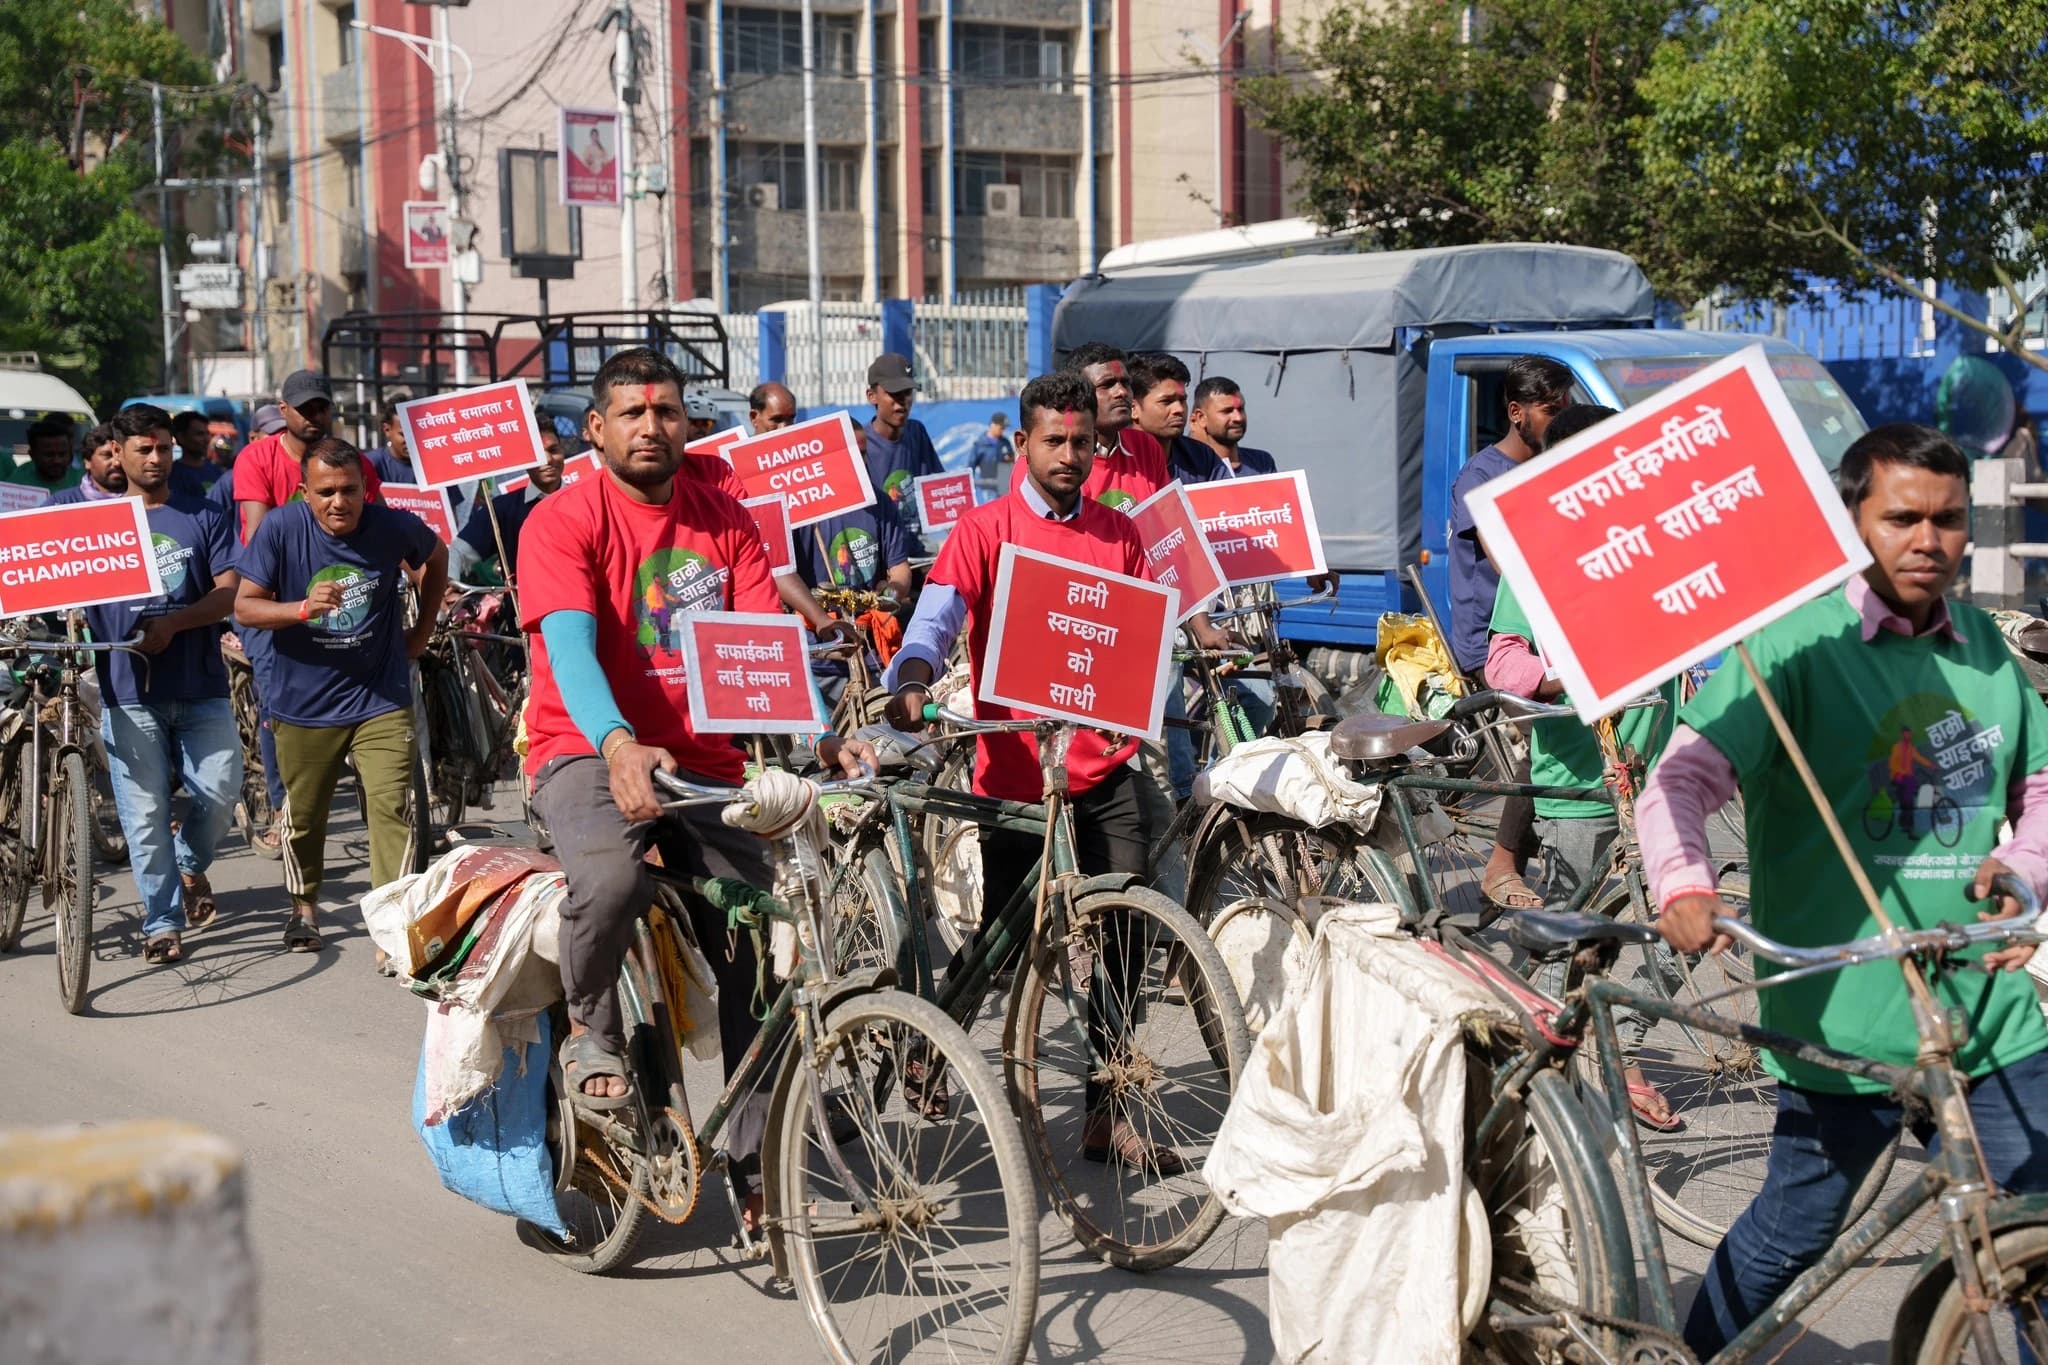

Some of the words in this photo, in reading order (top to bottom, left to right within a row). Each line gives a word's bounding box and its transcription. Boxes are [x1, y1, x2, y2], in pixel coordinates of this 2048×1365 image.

[459, 401, 503, 421] समानता
[505, 399, 514, 411] र
[452, 453, 473, 466] कल
[477, 445, 502, 461] यात्रा
[756, 439, 824, 471] HAMRO
[1548, 405, 1731, 521] सफाईकर्मीको
[769, 461, 826, 490] CYCLE
[384, 497, 442, 511] POWERING
[785, 482, 836, 510] ATRA
[1198, 502, 1293, 534] फाईकर्मीलाई
[1576, 525, 1654, 581] लागि
[1655, 464, 1765, 540] साईकल
[0, 530, 137, 564] #RECYCLING
[1209, 538, 1248, 555] म्मान
[2, 553, 140, 586] CHAMPIONS
[1066, 580, 1109, 610] हामी
[1653, 561, 1727, 616] यात्रा
[714, 639, 784, 663] सफाईकर्मी
[1067, 647, 1094, 676] को
[716, 665, 744, 688] लाई
[745, 670, 791, 688] सम्मान
[1049, 682, 1096, 712] साथी
[1935, 724, 2005, 770] साइकल
[1943, 759, 1985, 791] यात्रा
